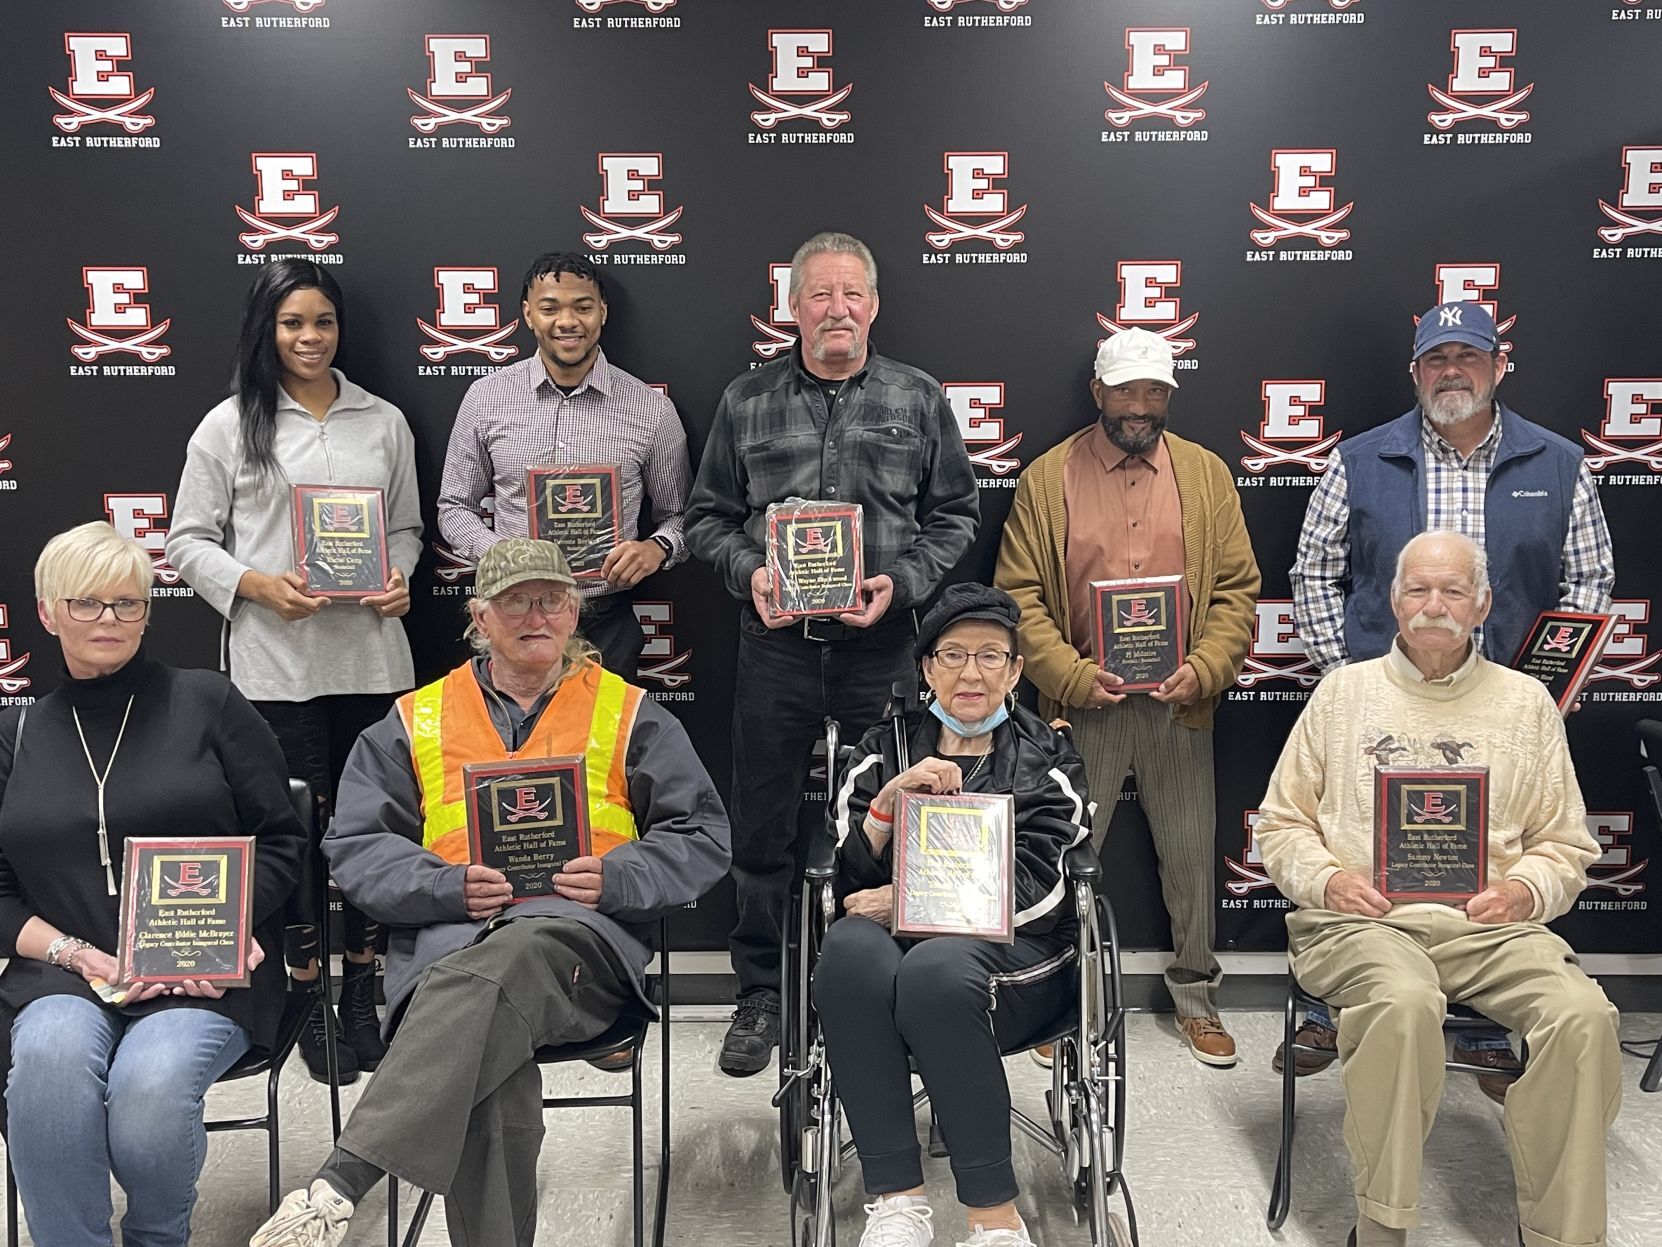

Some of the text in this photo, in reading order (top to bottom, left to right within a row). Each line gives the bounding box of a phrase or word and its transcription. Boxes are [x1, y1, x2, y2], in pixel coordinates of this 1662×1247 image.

[1255, 12, 1365, 25] EAST RUTHERFORD
[1611, 9, 1642, 20] EAST
[221, 16, 330, 28] EAST RUTHERFORD
[573, 17, 681, 28] EAST RUTHERFORD
[924, 15, 1032, 27] EAST RUTHERFORD
[64, 32, 134, 98] E
[768, 29, 832, 94] E
[1125, 27, 1190, 93] E
[1448, 28, 1517, 95] E
[424, 34, 492, 99] E
[51, 136, 161, 148] EAST RUTHERFORD
[748, 132, 855, 144] EAST RUTHERFORD
[1101, 130, 1209, 142] EAST RUTHERFORD
[1423, 132, 1532, 145] EAST RUTHERFORD
[408, 137, 515, 148] EAST RUTHERFORD
[251, 152, 319, 217] E
[598, 152, 663, 217] E
[944, 152, 1008, 216] E
[1270, 149, 1336, 213] E
[922, 252, 1028, 264] EAST RUTHERFORD
[1246, 249, 1353, 262] EAST RUTHERFORD
[1592, 247, 1662, 259] EAST RUTHE
[237, 254, 265, 265] EAST
[583, 254, 686, 265] AST RUTHERFORD
[83, 266, 151, 330] E
[433, 266, 501, 330] E
[1116, 260, 1182, 324] E
[1439, 306, 1463, 327] NY
[69, 365, 176, 376] EAST RUTHERFORD
[418, 365, 505, 376] EAST RUTHER
[1260, 379, 1325, 442] E
[1600, 378, 1662, 440] E
[975, 478, 1021, 490] HERFOR
[1237, 476, 1322, 487] EAST RUTHERF
[1608, 474, 1662, 486] RUTHERF
[149, 587, 195, 598] ERFORD
[432, 586, 460, 596] EAST
[1130, 599, 1149, 617] E
[1554, 626, 1574, 643] E
[0, 696, 36, 707] RFORD
[647, 691, 696, 702] HERFORD
[1228, 691, 1311, 702] EAST RUTHERF
[1592, 692, 1662, 703] RUTHERFORD
[516, 786, 540, 810] E
[1423, 792, 1446, 812] E
[502, 831, 556, 843] East Rutherford
[1407, 833, 1457, 841] East Rutherford
[494, 840, 567, 853] Athletic Hall of Fame
[1399, 842, 1468, 850] Athletic Hall of Fame
[508, 855, 531, 864] Wanda
[533, 852, 555, 862] Berry
[1407, 853, 1459, 862] Sammy Newton
[178, 862, 203, 884] E
[525, 881, 542, 890] 2020
[1221, 899, 1289, 910] EAST RUTHE
[1578, 900, 1648, 911] RUTHERFORD
[158, 908, 215, 917] East Rutherford
[149, 918, 178, 926] Athletic
[180, 918, 196, 926] Hall
[197, 918, 205, 926] of
[139, 931, 172, 939] Clarence
[198, 930, 235, 939] McBrayer
[176, 960, 196, 968] 2020
